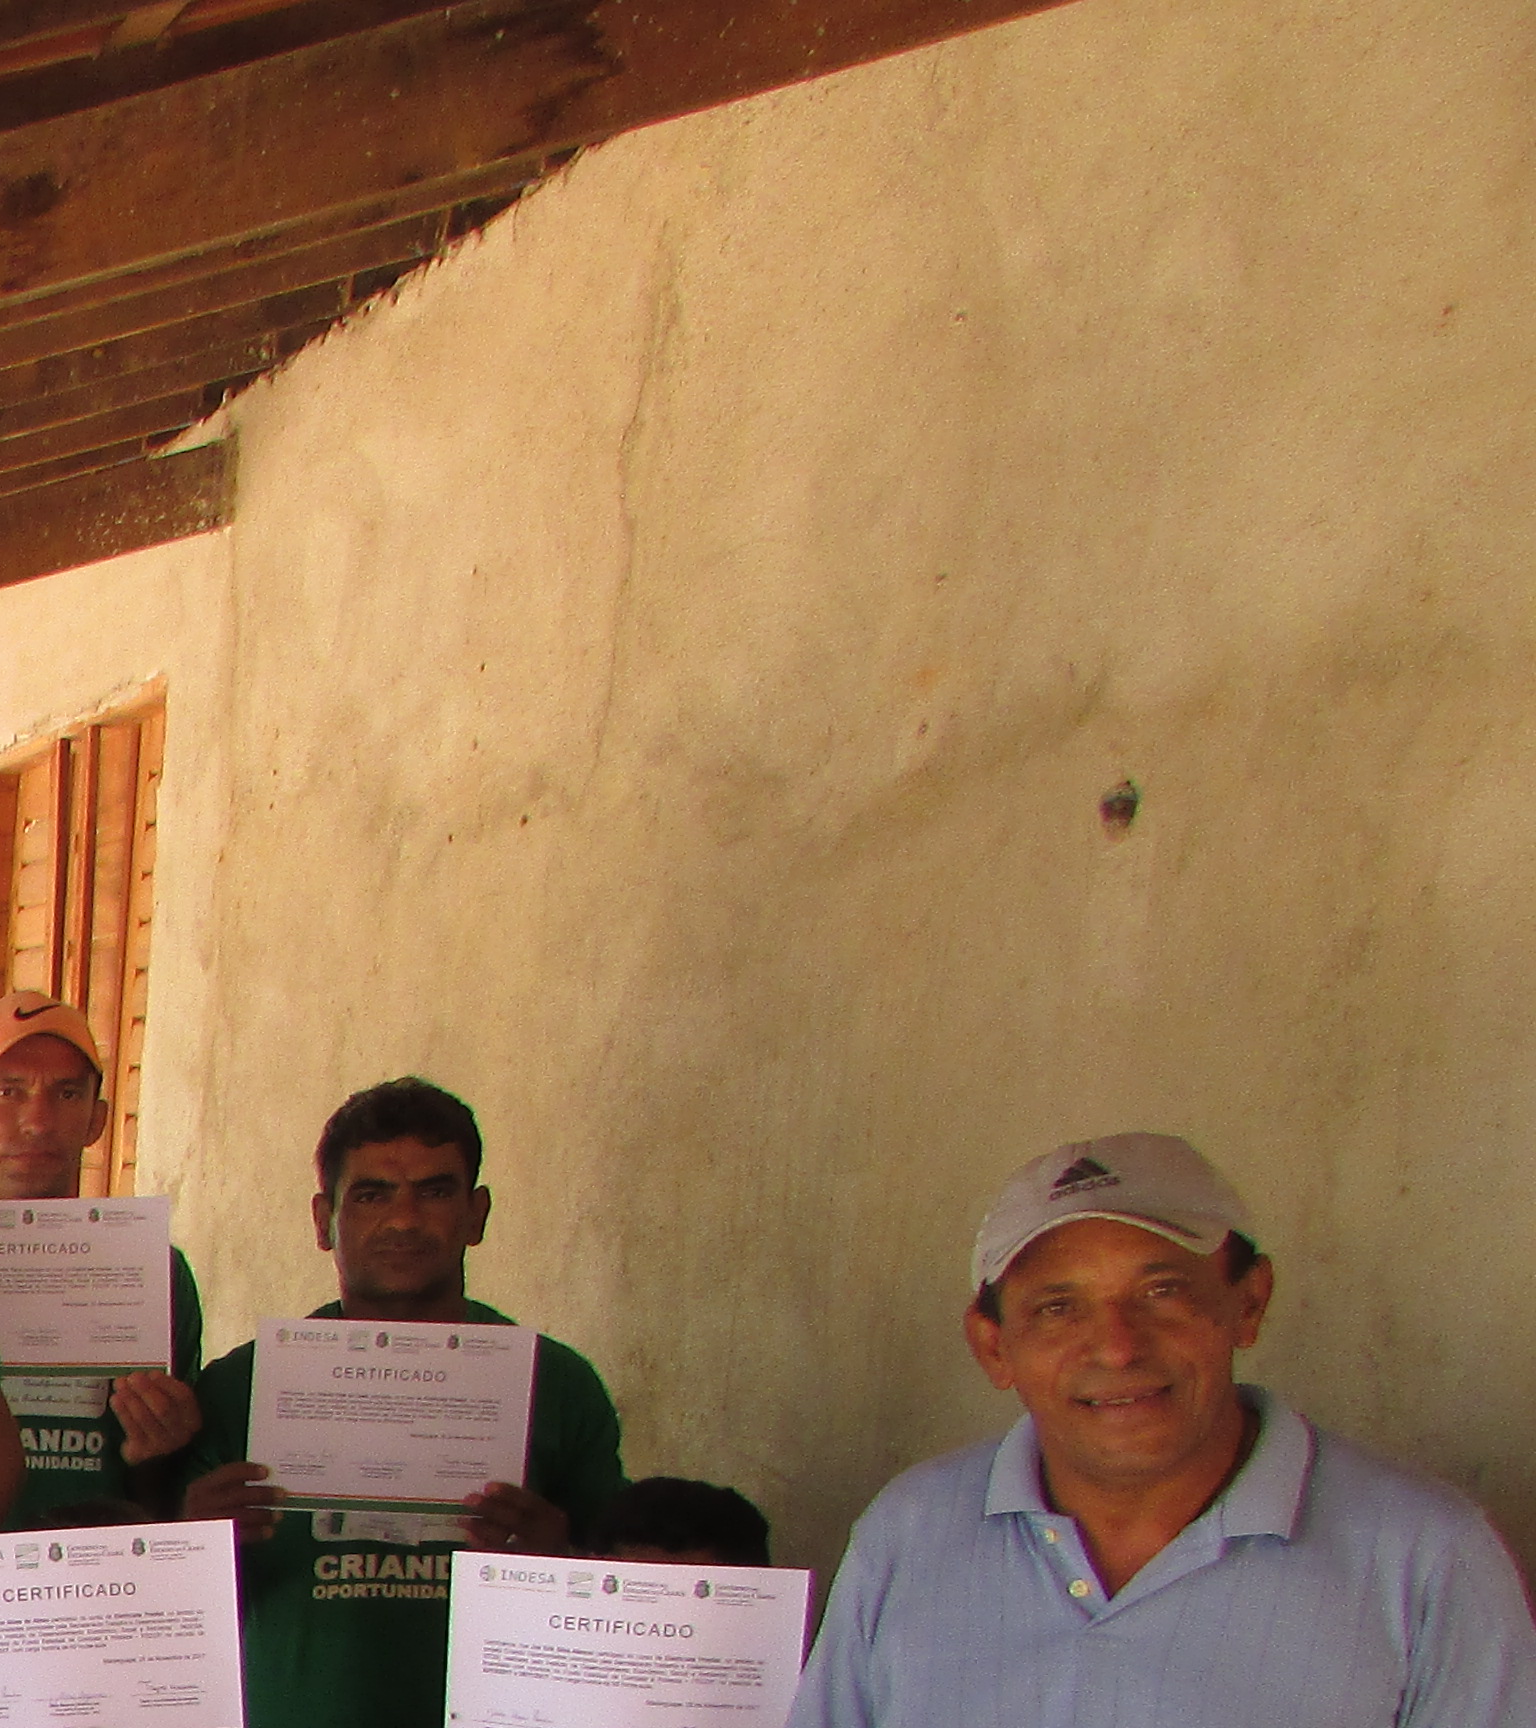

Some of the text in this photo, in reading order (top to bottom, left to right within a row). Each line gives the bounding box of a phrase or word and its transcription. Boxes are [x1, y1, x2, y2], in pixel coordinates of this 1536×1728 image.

[332, 1366, 446, 1383] CERTIFICADO
[500, 1569, 556, 1584] INDESA
[2, 1582, 137, 1603] CERTIFICADO
[548, 1614, 694, 1639] CERTIFICADO
